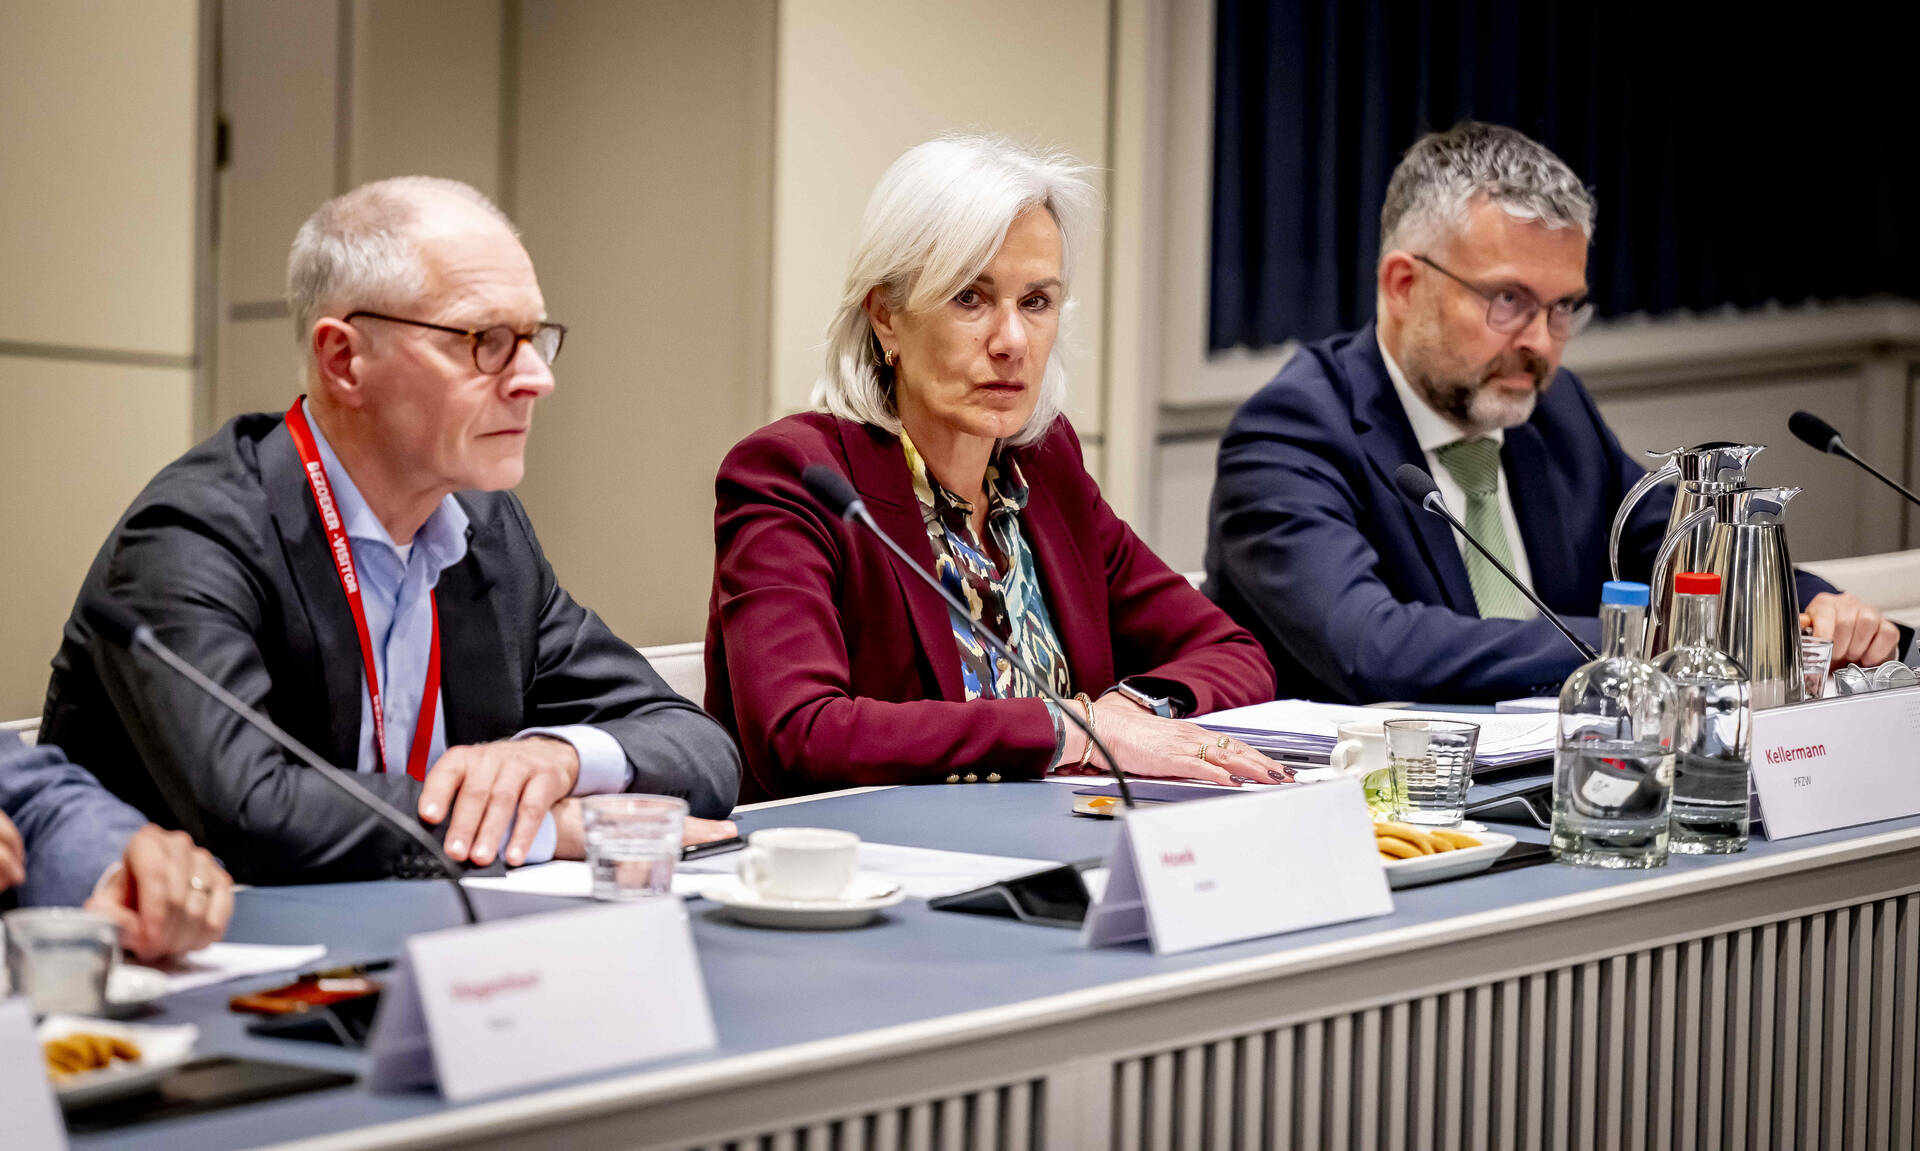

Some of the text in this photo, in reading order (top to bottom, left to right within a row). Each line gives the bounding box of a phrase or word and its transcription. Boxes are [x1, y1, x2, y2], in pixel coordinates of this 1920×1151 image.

[306, 461, 340, 531] BEZOEKER
[1765, 743, 1827, 765] Kellermann
[1793, 776, 1812, 788] PFZW
